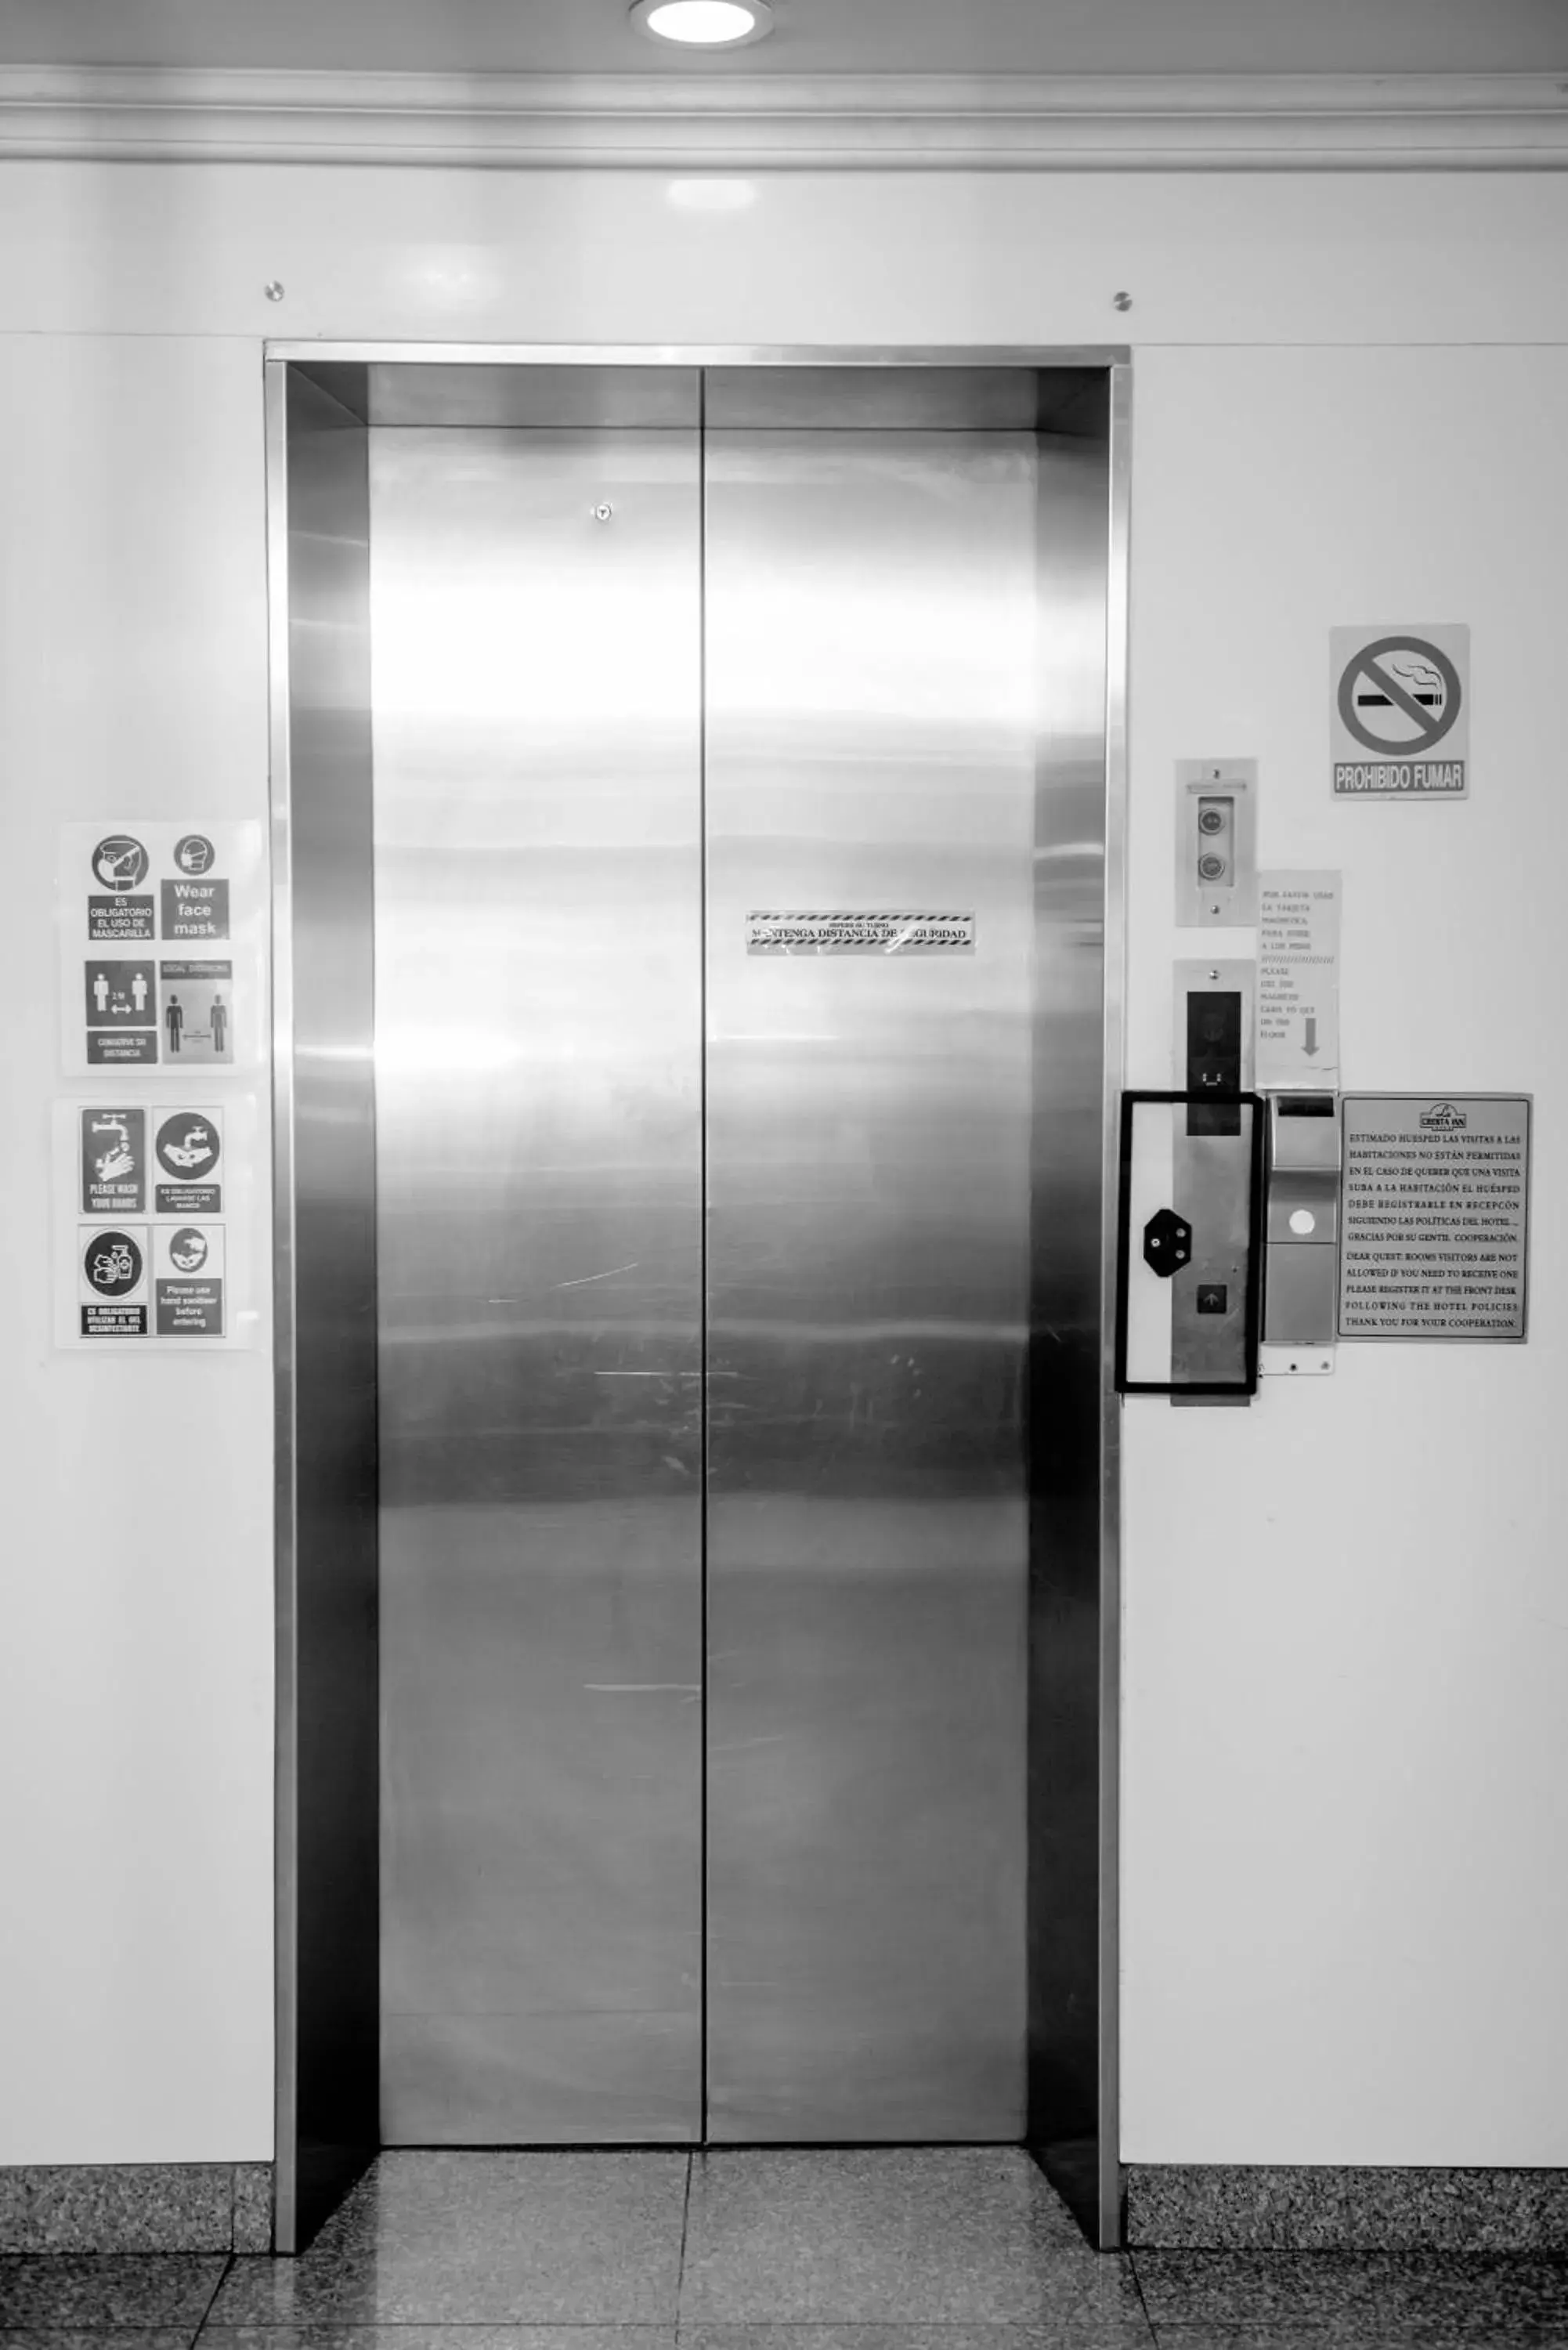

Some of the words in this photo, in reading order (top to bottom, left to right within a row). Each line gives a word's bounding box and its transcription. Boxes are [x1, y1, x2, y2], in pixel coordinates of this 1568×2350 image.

[1336, 765, 1410, 790] PROHIBIDO
[1414, 764, 1461, 789] FUMAR
[174, 884, 215, 898] Wear
[115, 898, 127, 906] ES
[90, 908, 152, 917] OBLIGATORIO
[178, 903, 211, 916] face
[175, 921, 216, 935] mask
[752, 928, 815, 937] MNTENGA
[818, 928, 878, 938] DISTANCIA
[881, 928, 897, 938] DE
[92, 929, 151, 938] MASCARILLA
[1349, 1134, 1396, 1143] ESTIMADO
[1497, 1136, 1503, 1144] A
[1349, 1151, 1417, 1159] HABITACIONES
[1419, 1151, 1433, 1159] NO
[1349, 1166, 1360, 1176] EN
[1364, 1166, 1373, 1176] EL
[1472, 1168, 1491, 1177] UNA
[1492, 1168, 1521, 1177] VISITA
[1462, 1184, 1472, 1193] EL
[1348, 1199, 1375, 1209] DEBE
[1449, 1201, 1462, 1209] EN
[1348, 1233, 1384, 1242] GRACIAS
[1498, 1253, 1518, 1262] NOT
[1346, 1269, 1389, 1278] ALLOWED
[1400, 1269, 1419, 1278] YOU
[1499, 1271, 1518, 1279] ONE
[1346, 1301, 1406, 1311] FOLLOWING
[1409, 1301, 1430, 1311] THE
[1346, 1318, 1378, 1326] THANK
[1379, 1318, 1399, 1326] YOU
